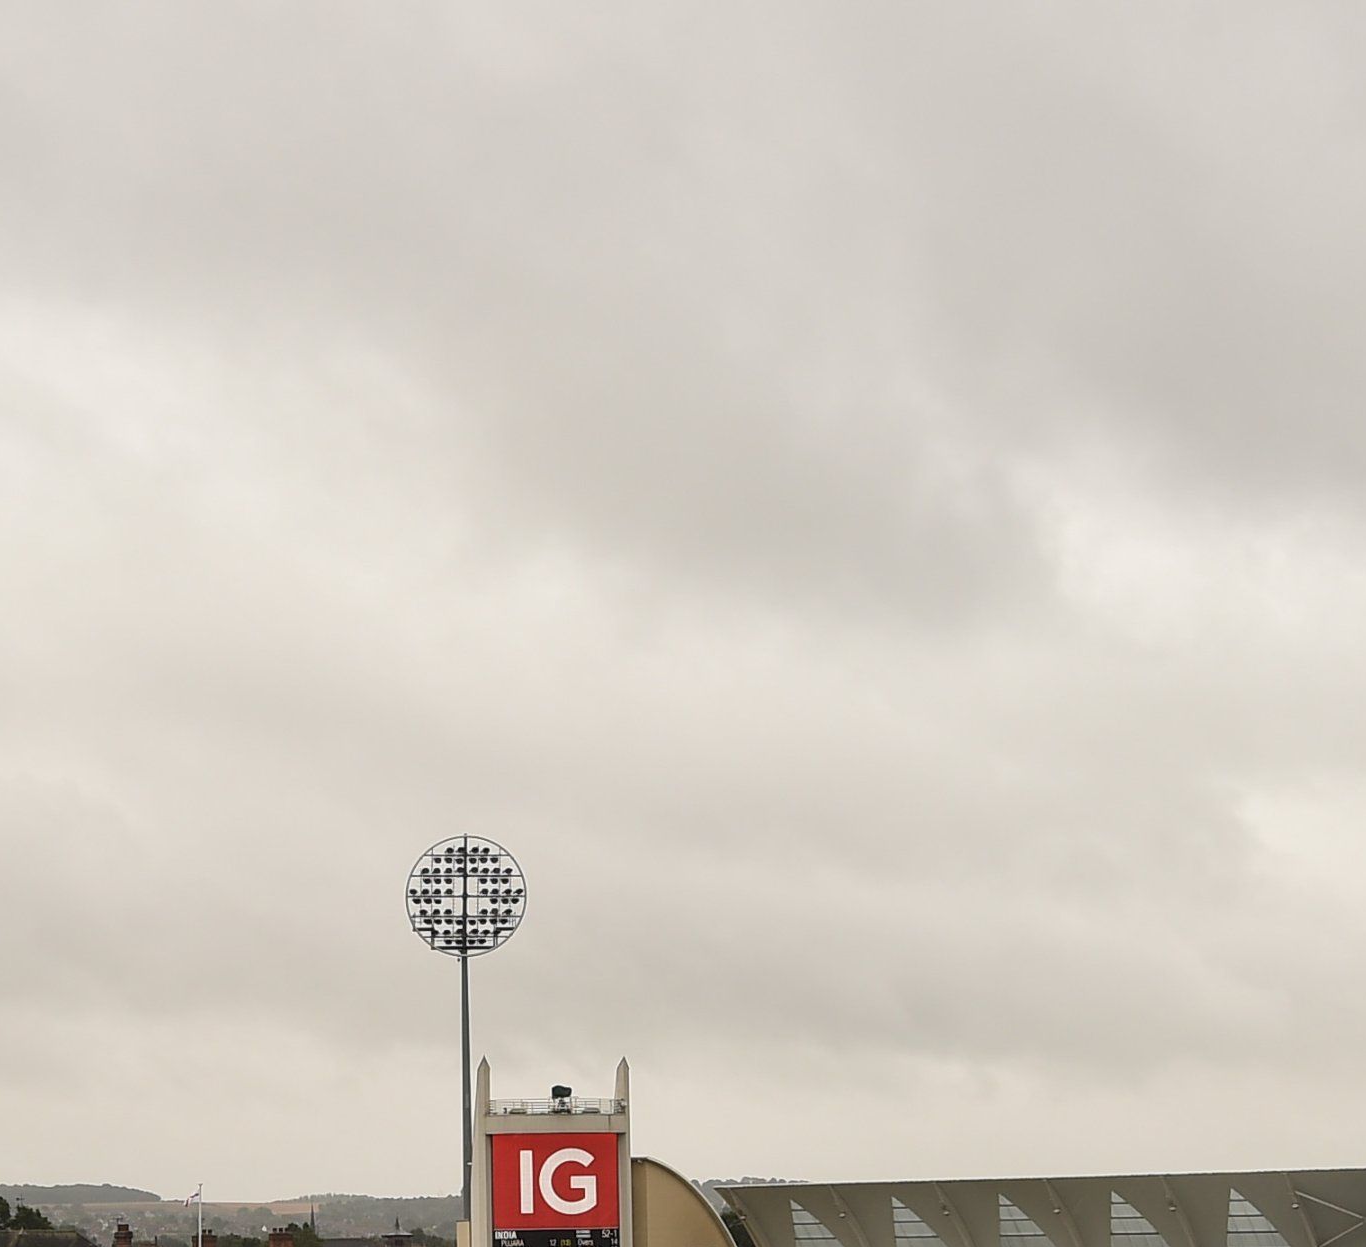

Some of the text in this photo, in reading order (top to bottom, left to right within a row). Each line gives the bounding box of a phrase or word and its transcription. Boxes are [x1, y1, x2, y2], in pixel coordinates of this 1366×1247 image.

[520, 1147, 597, 1215] IG
[495, 1230, 618, 1240] INDIA 52-1
